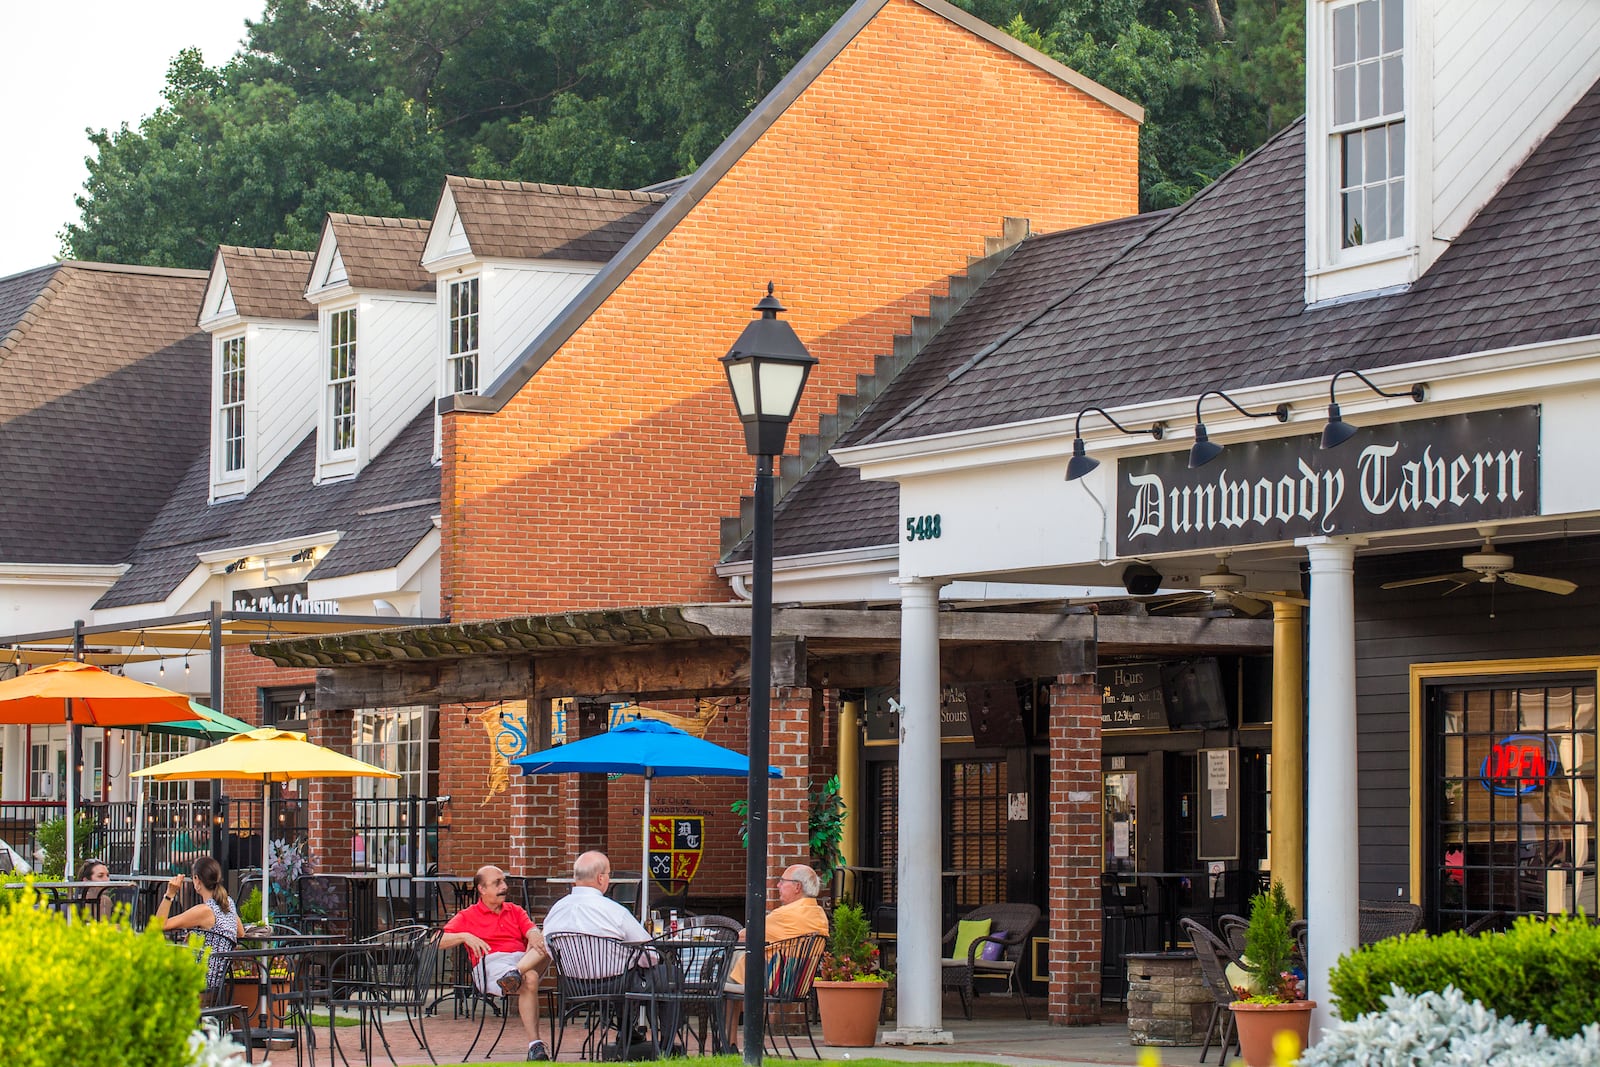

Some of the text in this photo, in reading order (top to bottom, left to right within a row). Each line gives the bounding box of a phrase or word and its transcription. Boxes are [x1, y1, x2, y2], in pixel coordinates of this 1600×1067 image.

[1128, 440, 1523, 542] Dunwoody Tavern
[906, 513, 941, 542] 5488
[259, 594, 289, 614] Thai
[291, 593, 340, 615] Cuisine
[1114, 669, 1144, 685] Hours
[941, 711, 967, 723] Stouts
[1486, 743, 1546, 786] OPEN
[632, 806, 714, 816] DWOODY TAVERN
